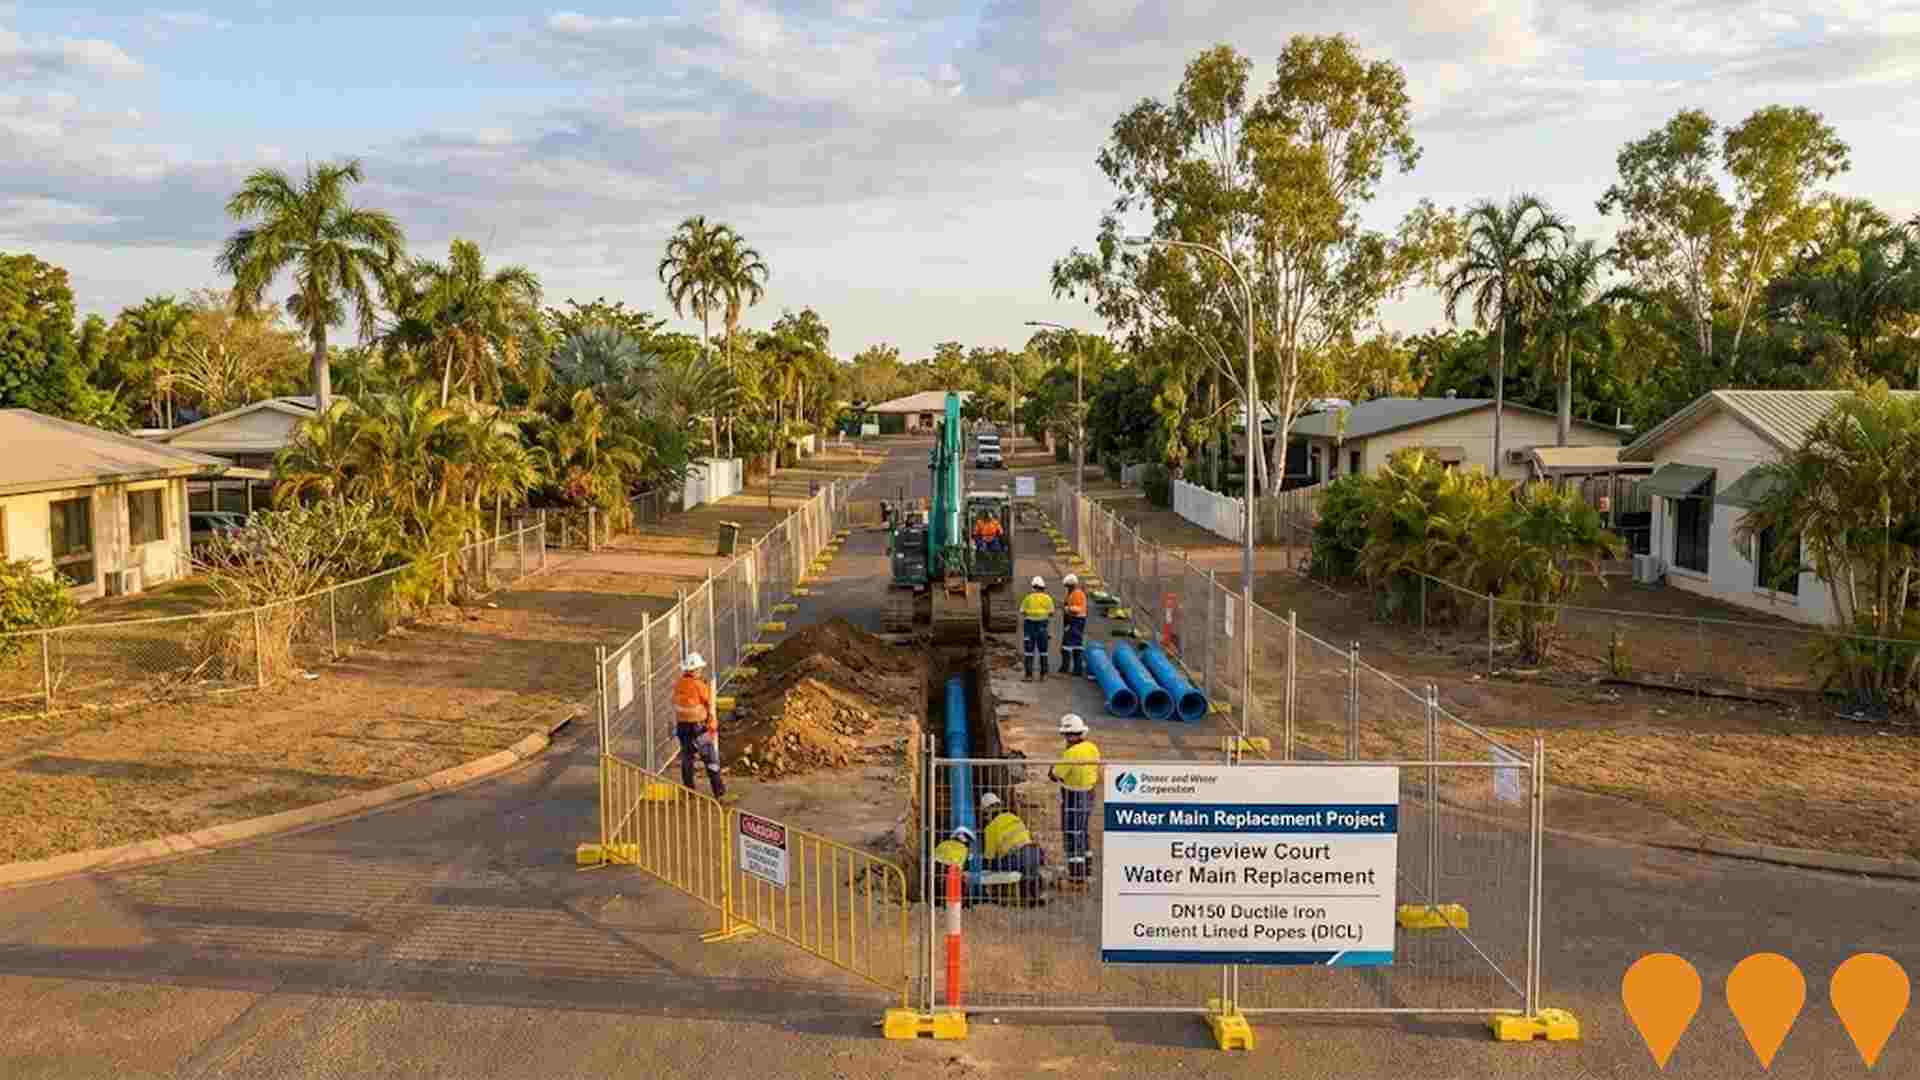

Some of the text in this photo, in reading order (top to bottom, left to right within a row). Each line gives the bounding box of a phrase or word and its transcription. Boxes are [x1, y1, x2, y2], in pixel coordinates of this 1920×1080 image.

[1115, 809, 1386, 830] Water Main Replacement Project
[1171, 841, 1330, 863] Edgeview Court
[1124, 865, 1375, 888] Water Main Replacement
[1171, 903, 1327, 919] DN150 Ductile Iron
[1133, 922, 1363, 943] Cement Lined Popes (DICL)
